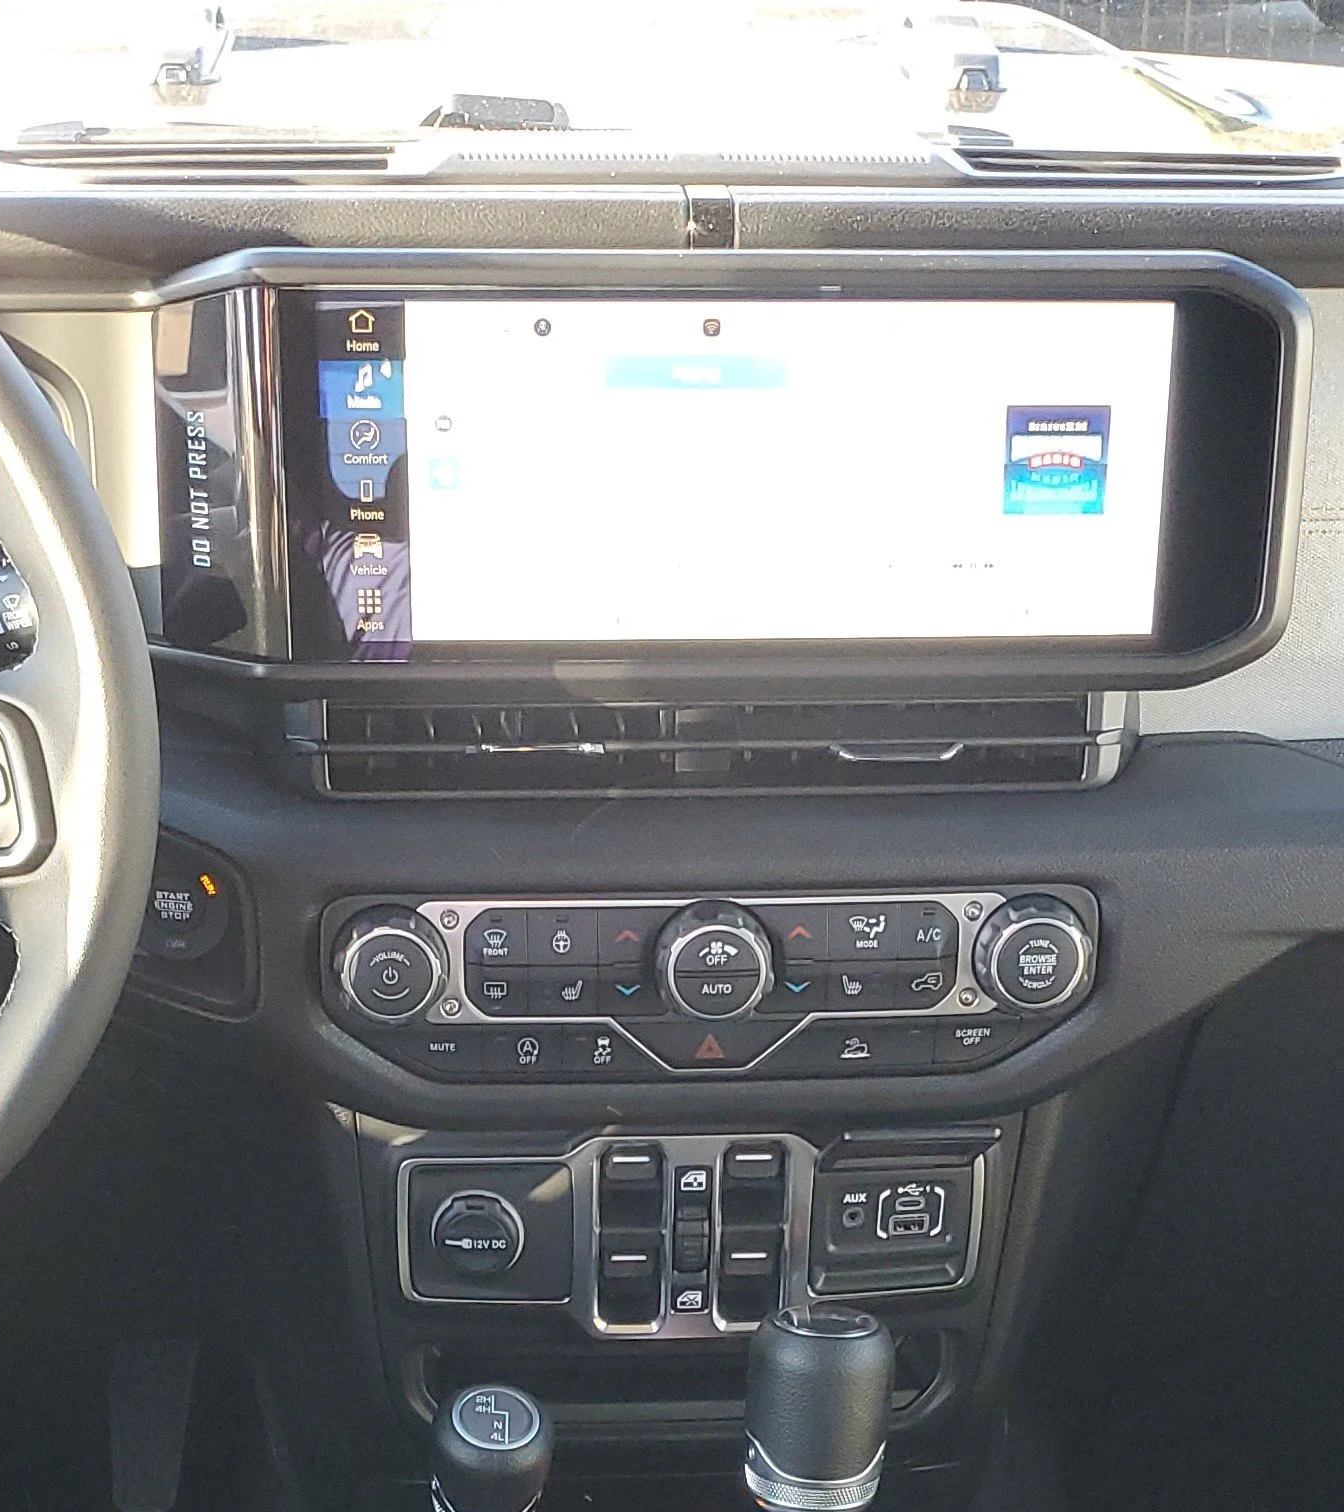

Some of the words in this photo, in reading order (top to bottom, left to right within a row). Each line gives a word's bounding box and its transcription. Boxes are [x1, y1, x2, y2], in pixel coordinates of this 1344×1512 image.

[346, 340, 380, 352] Home
[187, 411, 207, 480] PRESS
[343, 453, 388, 465] Comfort
[189, 488, 209, 530] NOT
[350, 508, 385, 521] Phone
[193, 540, 211, 568] DO
[350, 564, 388, 576] Vehicle
[357, 619, 384, 632] Apps
[156, 890, 190, 901] START
[160, 912, 190, 921] STOP
[917, 927, 941, 943] A/C
[856, 940, 879, 949] MODE
[1029, 939, 1051, 948] TUNE
[373, 951, 405, 964] VOLUME
[483, 948, 508, 957] FRONT
[706, 953, 728, 967] OFF
[1019, 954, 1057, 963] BROWSE
[1024, 966, 1053, 975] ENTER
[701, 983, 732, 996] AUTO
[955, 1028, 991, 1038] SCREEN
[963, 1037, 981, 1046] OFF
[430, 1043, 455, 1051] MUTE
[519, 1055, 537, 1065] OFF
[593, 1055, 611, 1065] OFF
[843, 1192, 867, 1203] AUX
[473, 1239, 490, 1249] 12V
[492, 1239, 506, 1249] DC
[475, 1405, 491, 1413] 4H
[493, 1420, 503, 1430] N
[490, 1432, 505, 1441] 4L
